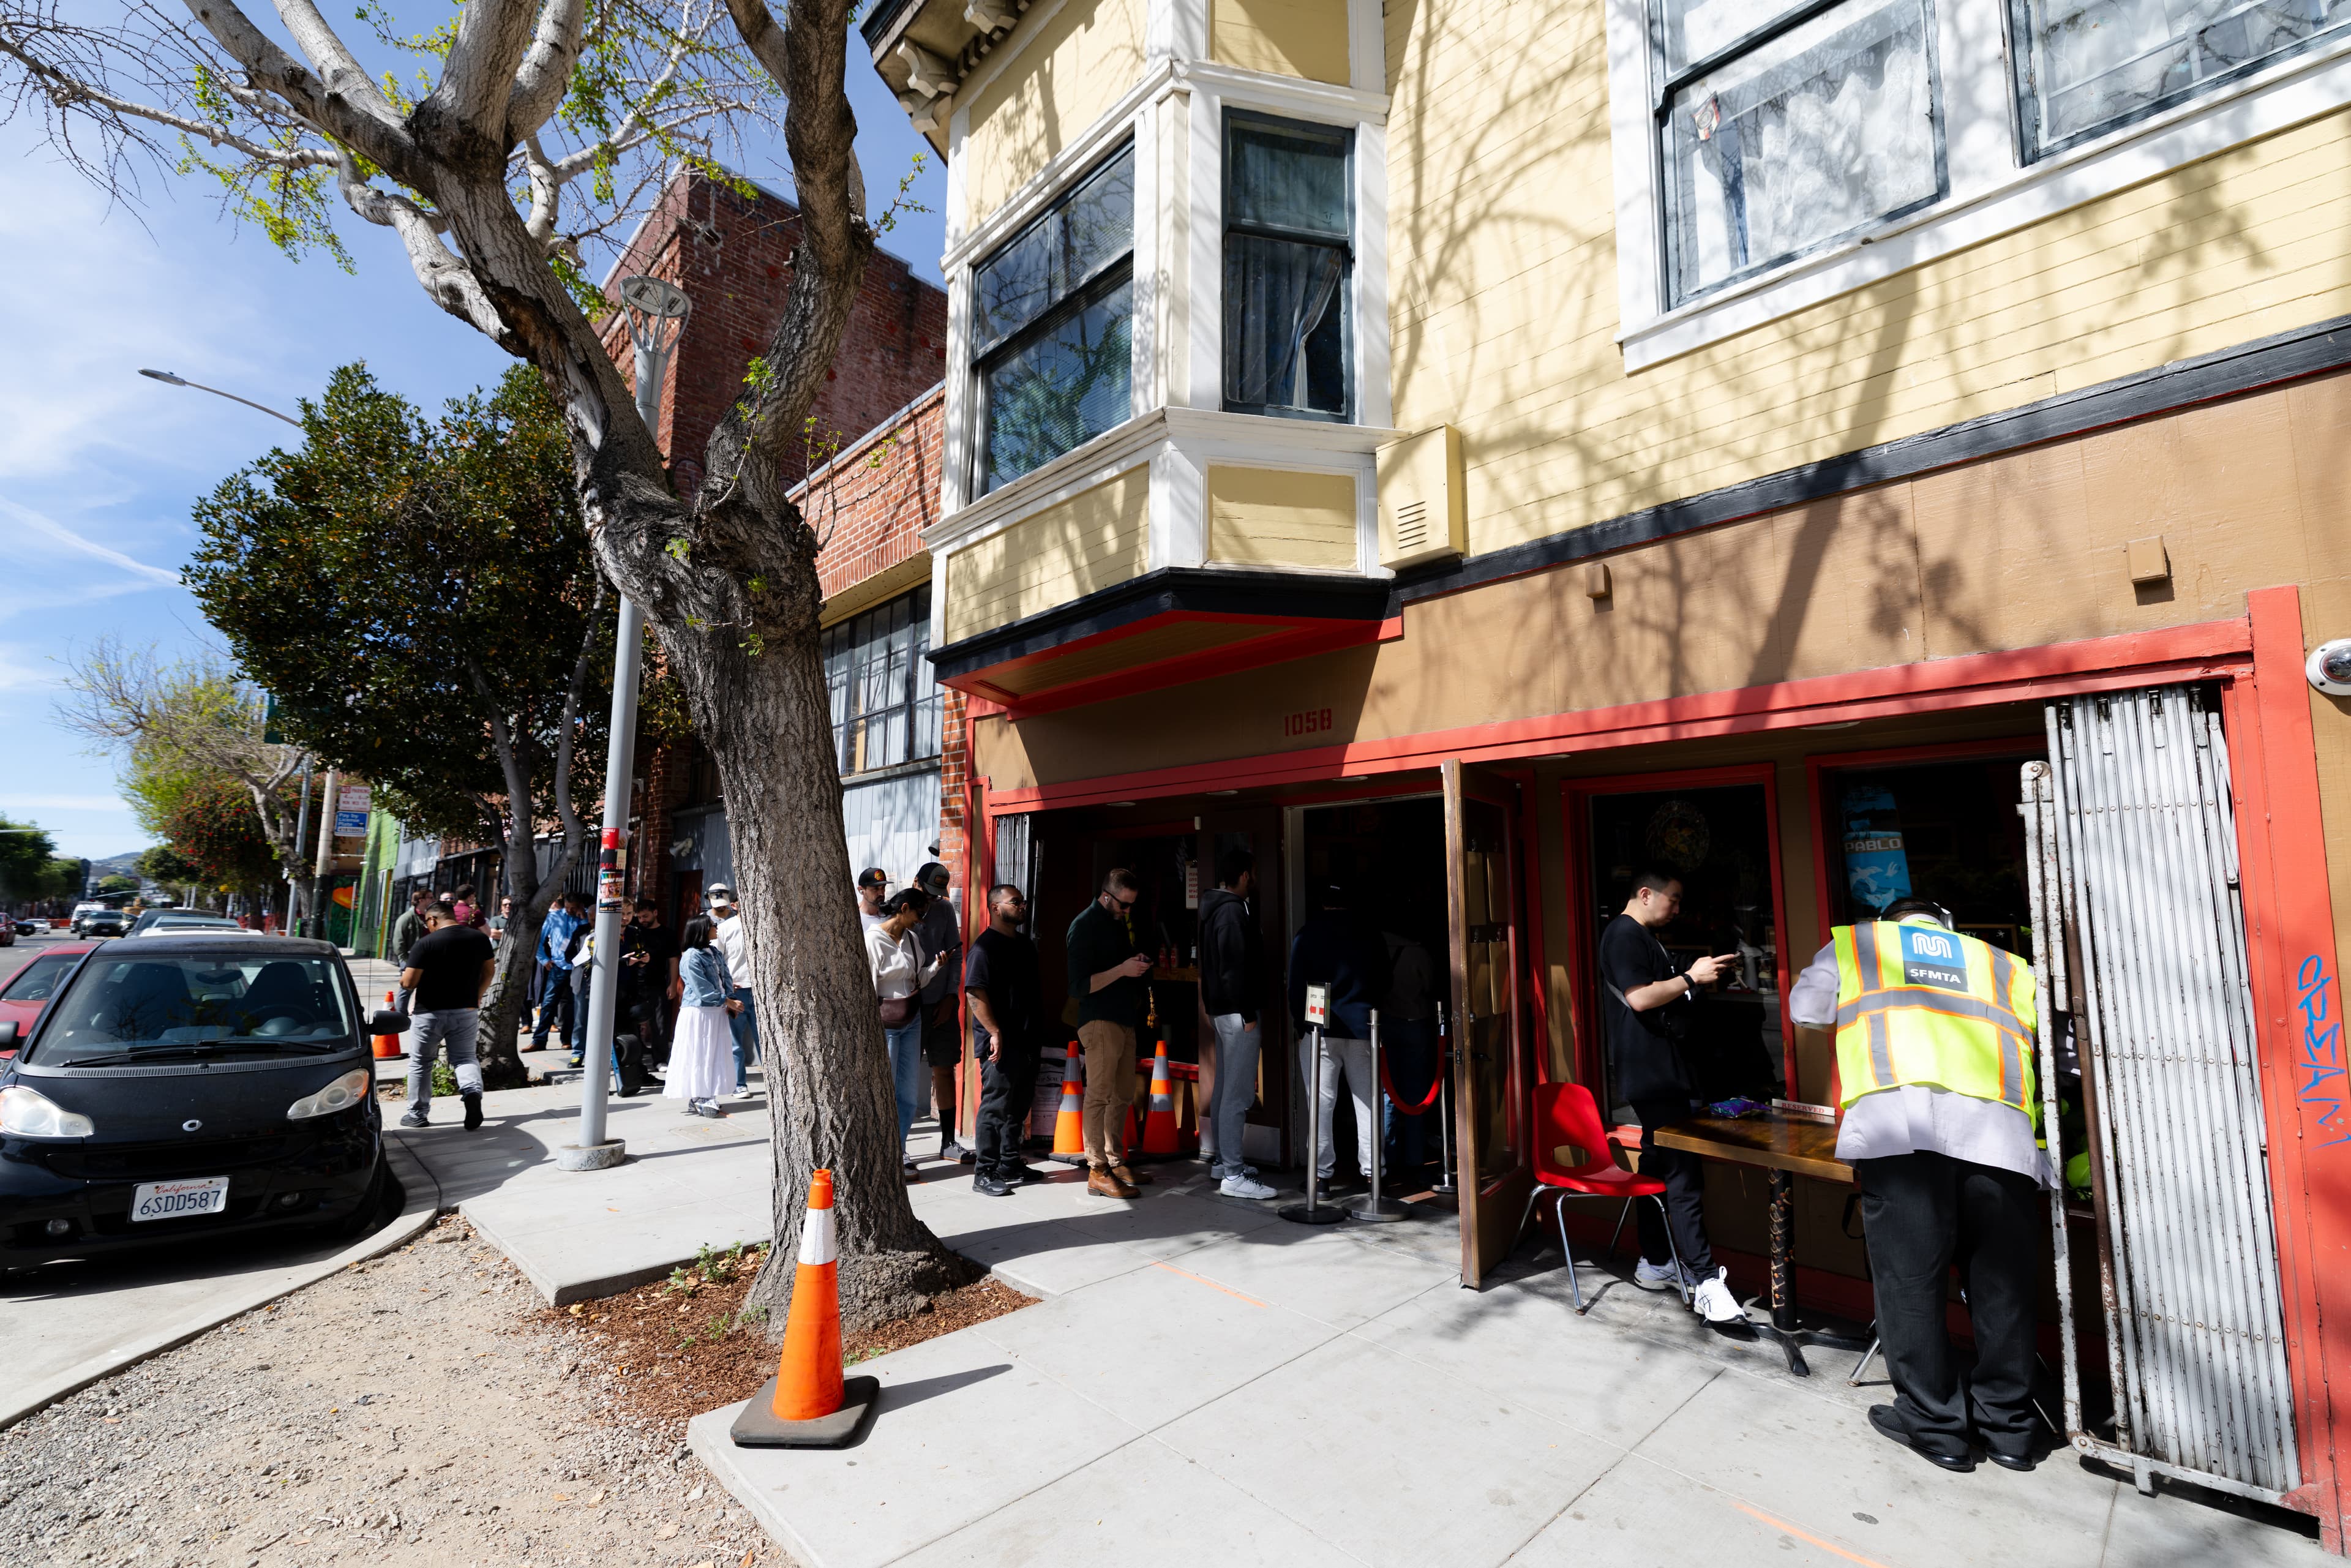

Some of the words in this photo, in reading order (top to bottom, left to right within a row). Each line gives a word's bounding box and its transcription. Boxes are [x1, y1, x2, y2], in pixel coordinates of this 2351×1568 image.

[1284, 708, 1332, 737] 1058
[1845, 838, 1900, 853] PABLO
[1910, 968, 1962, 984] SFMTA
[1782, 1102, 1824, 1114] RESERVED
[156, 1182, 211, 1195] California
[140, 1190, 221, 1215] 6SDD587
